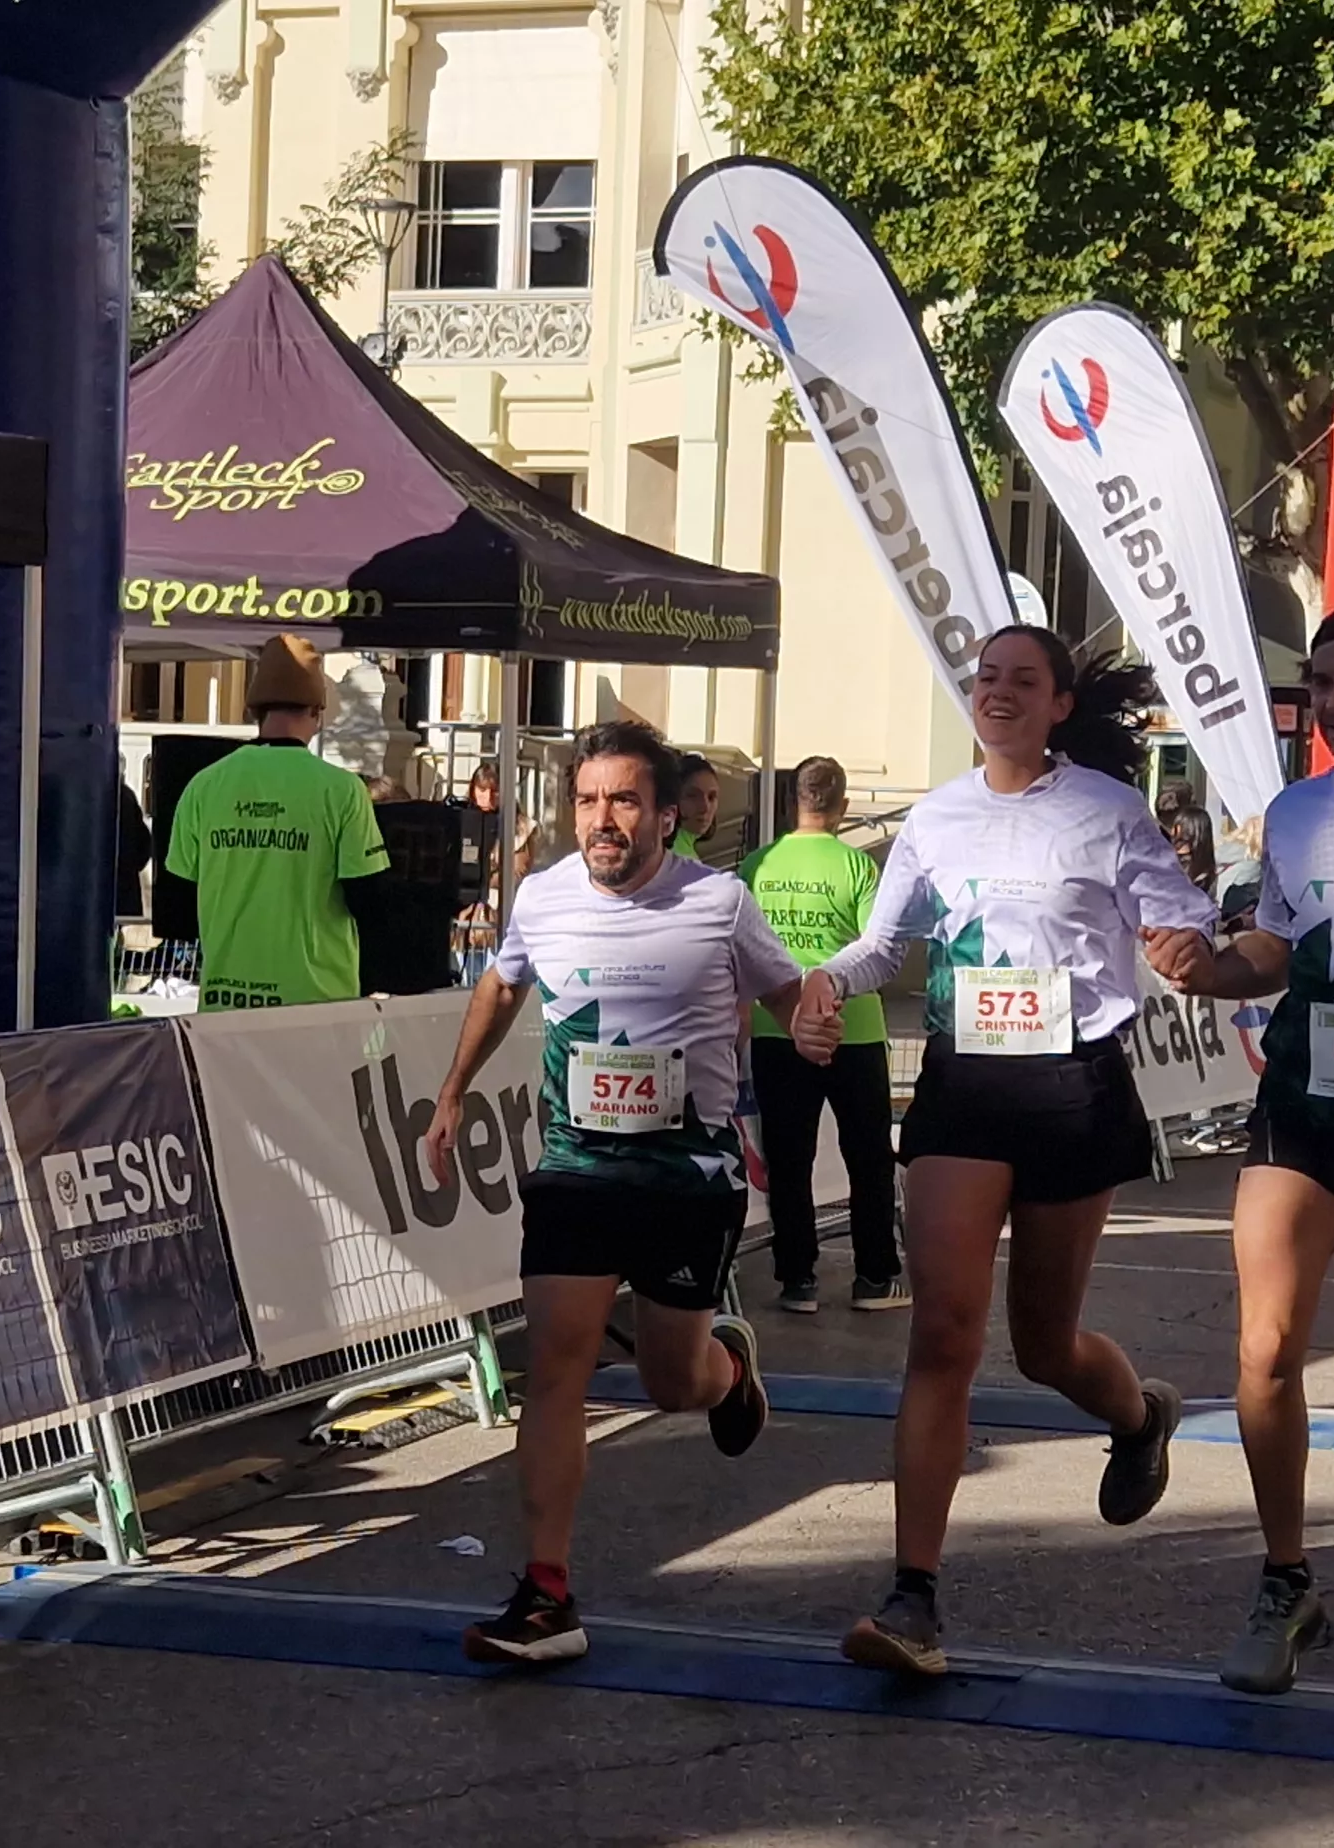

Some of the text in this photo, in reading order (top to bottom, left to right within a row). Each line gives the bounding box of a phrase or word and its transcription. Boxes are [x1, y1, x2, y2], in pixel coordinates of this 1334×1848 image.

[149, 478, 307, 522] Sport
[559, 586, 753, 652] www.fartlecksport.com
[209, 827, 310, 853] ORGANIZACIÓN
[762, 909, 837, 929] FARTLECK
[777, 931, 825, 950] SPORT
[976, 990, 1040, 1017] 573
[975, 1020, 1045, 1032] CRISTINA
[593, 1073, 657, 1101] 574
[590, 1101, 660, 1115] MARIANO
[81, 1133, 192, 1222] ESIC
